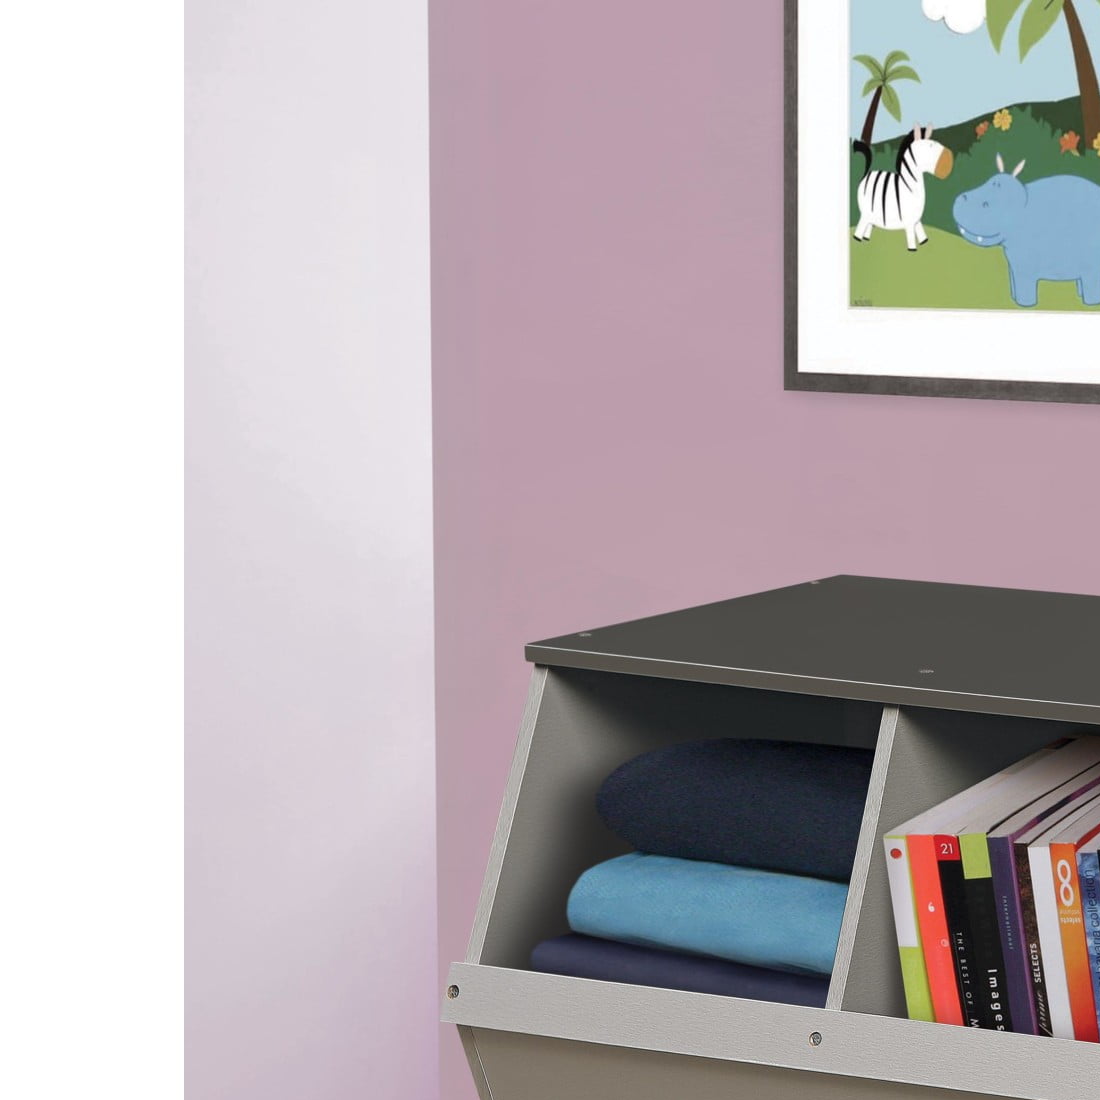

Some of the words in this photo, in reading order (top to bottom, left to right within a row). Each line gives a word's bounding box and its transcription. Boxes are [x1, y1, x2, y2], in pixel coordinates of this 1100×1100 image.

[940, 843, 953, 854] 21
[1084, 869, 1100, 928] collection
[956, 932, 965, 951] THE
[960, 959, 970, 984] BEST
[1030, 943, 1042, 984] SELECTS
[965, 991, 974, 1005] OF
[987, 968, 1005, 1031] Images
